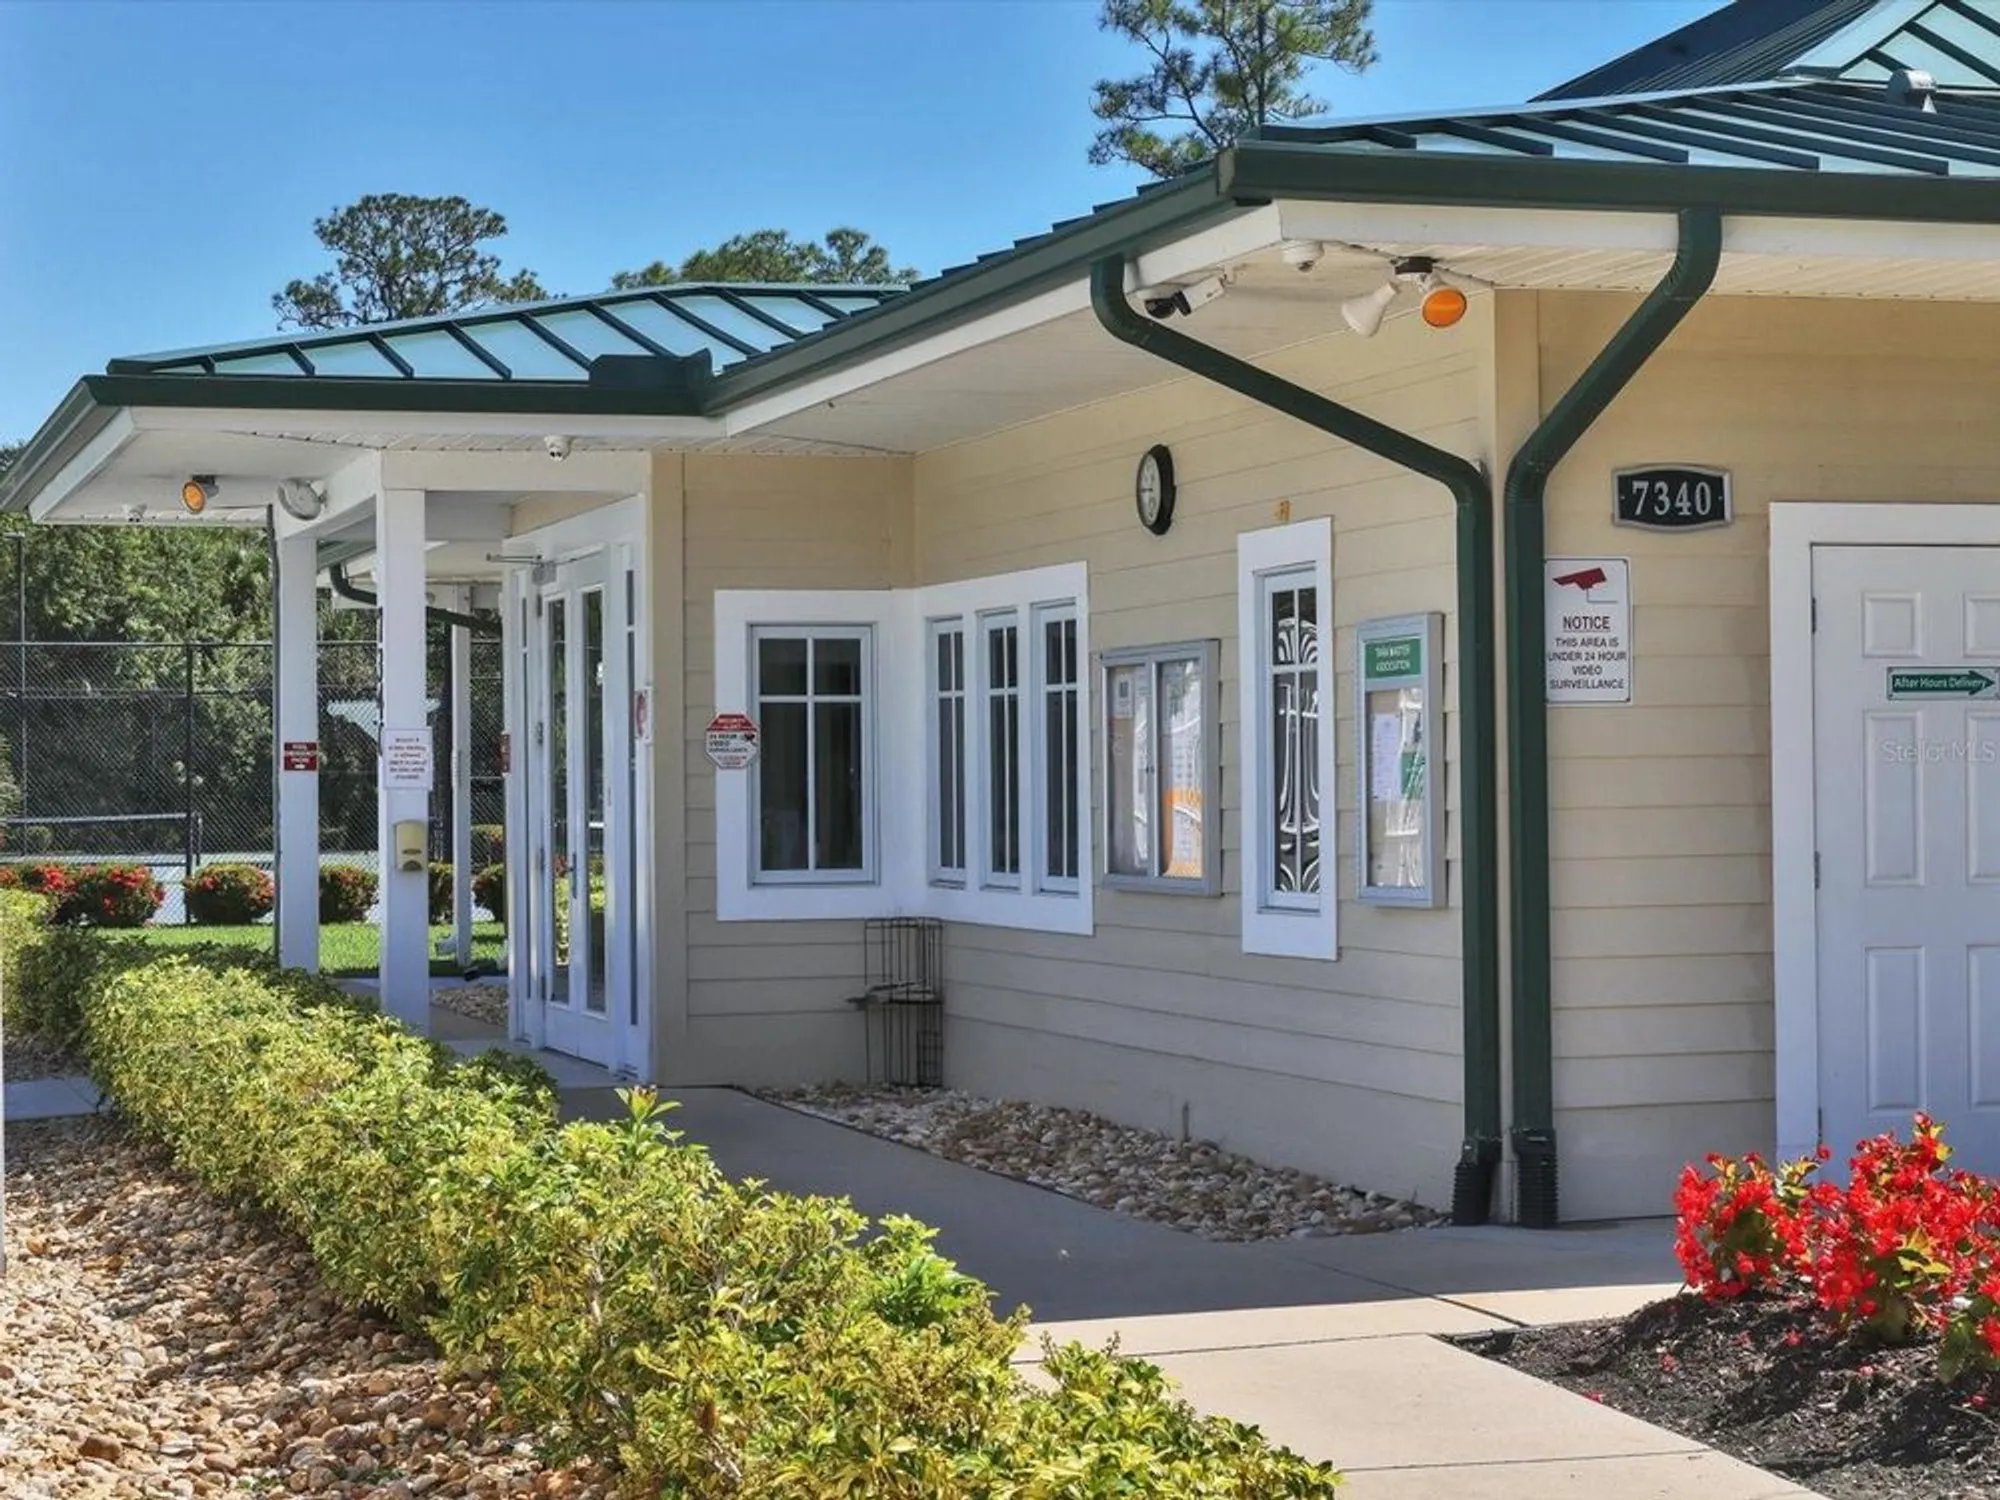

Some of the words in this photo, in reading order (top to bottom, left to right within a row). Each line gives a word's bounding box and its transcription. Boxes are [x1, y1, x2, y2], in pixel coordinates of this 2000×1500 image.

[1631, 480, 1711, 516] 7340
[1562, 615, 1611, 630] NOTICE
[1555, 637, 1578, 648] THIS
[1580, 637, 1607, 648] AREA
[1609, 637, 1619, 648] IS
[1548, 651, 1583, 662] UNDER
[1584, 651, 1596, 662] 24
[1598, 651, 1627, 662] HOUR
[1572, 664, 1603, 676] VIDEO
[1549, 679, 1625, 690] SURVEILLANCE
[1894, 676, 1919, 689] After
[1920, 676, 1947, 689] Hours
[1948, 676, 1986, 690] Delivery
